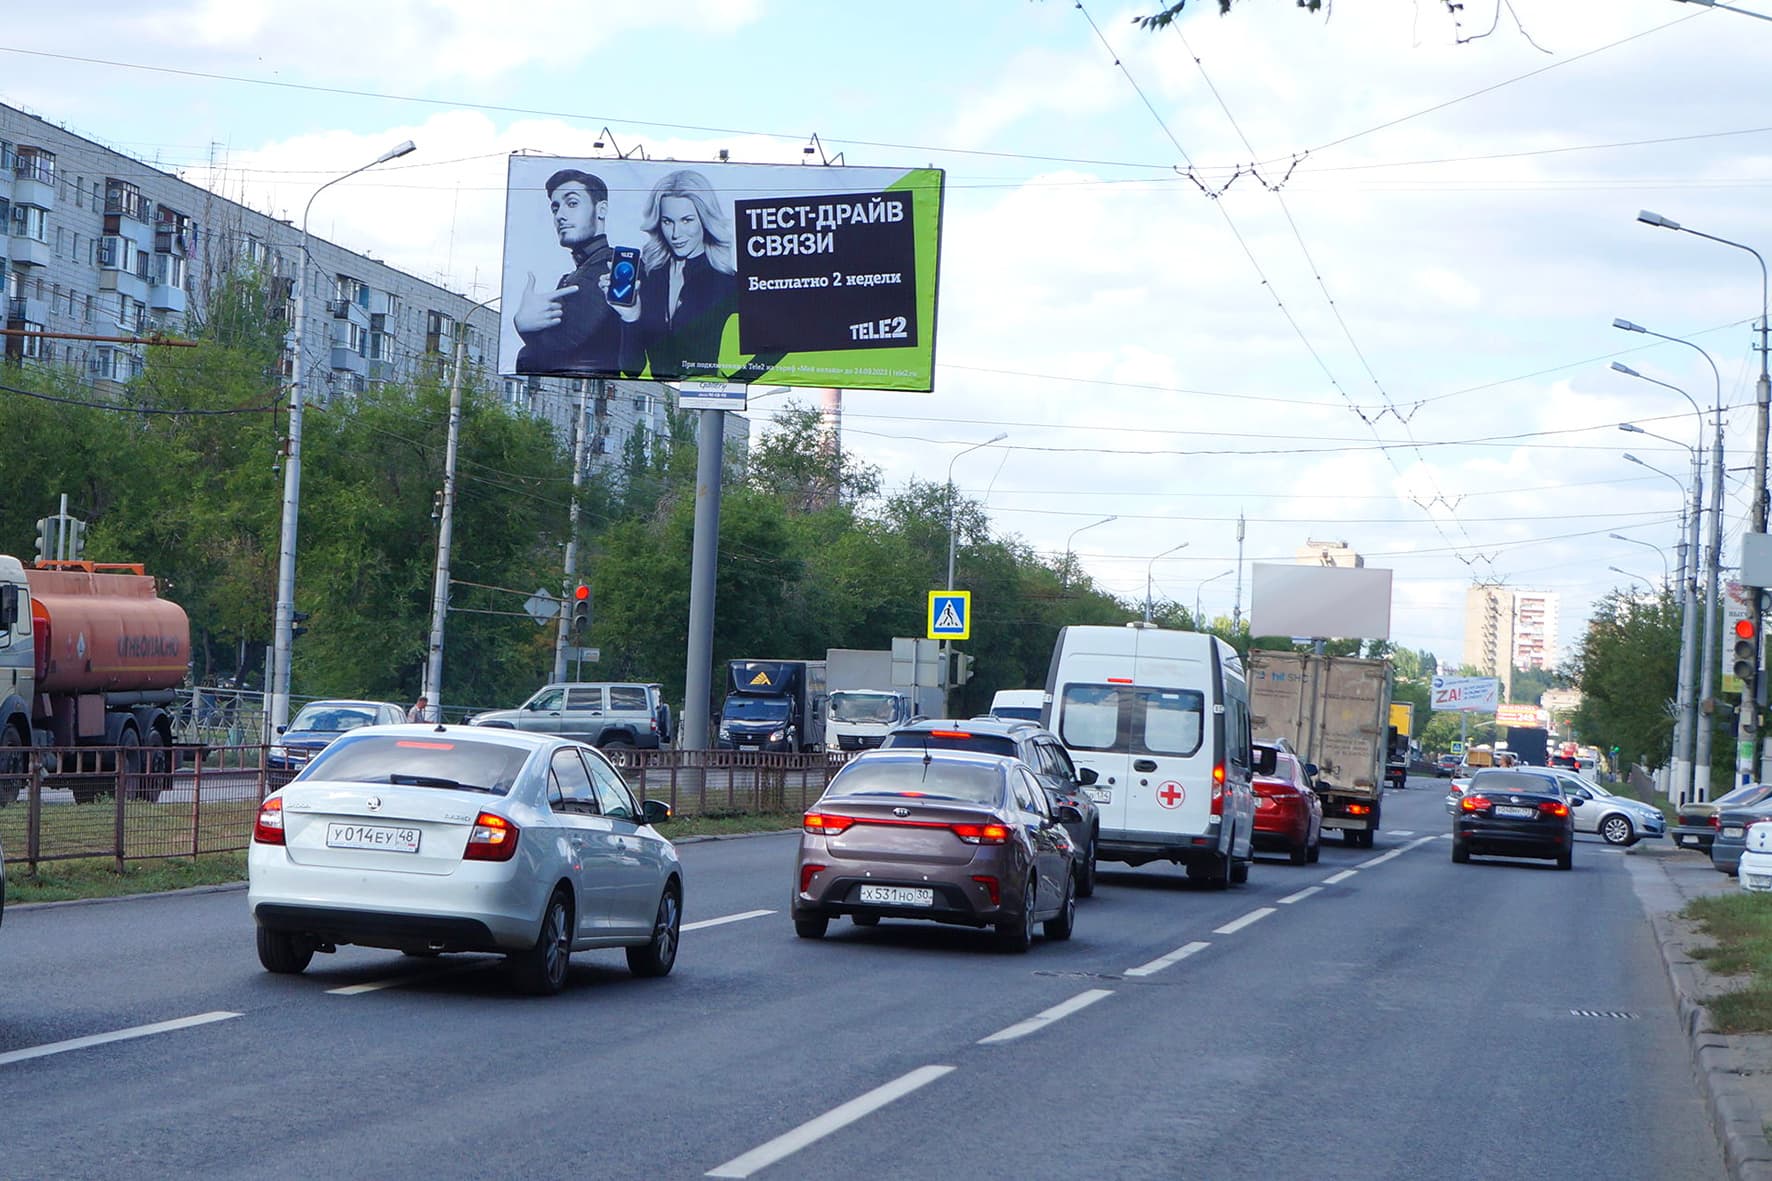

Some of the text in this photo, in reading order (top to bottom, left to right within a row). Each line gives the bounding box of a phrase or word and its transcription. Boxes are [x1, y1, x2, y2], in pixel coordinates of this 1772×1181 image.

[746, 197, 904, 231] ТЕСТ-ДРАЙВ
[747, 232, 835, 258] СВЯЗИ
[748, 271, 902, 291] Бесплатно 2 недели
[849, 316, 908, 341] TELE2
[1435, 687, 1462, 703] ZA!
[398, 830, 415, 843] 48
[916, 889, 930, 900] 30
